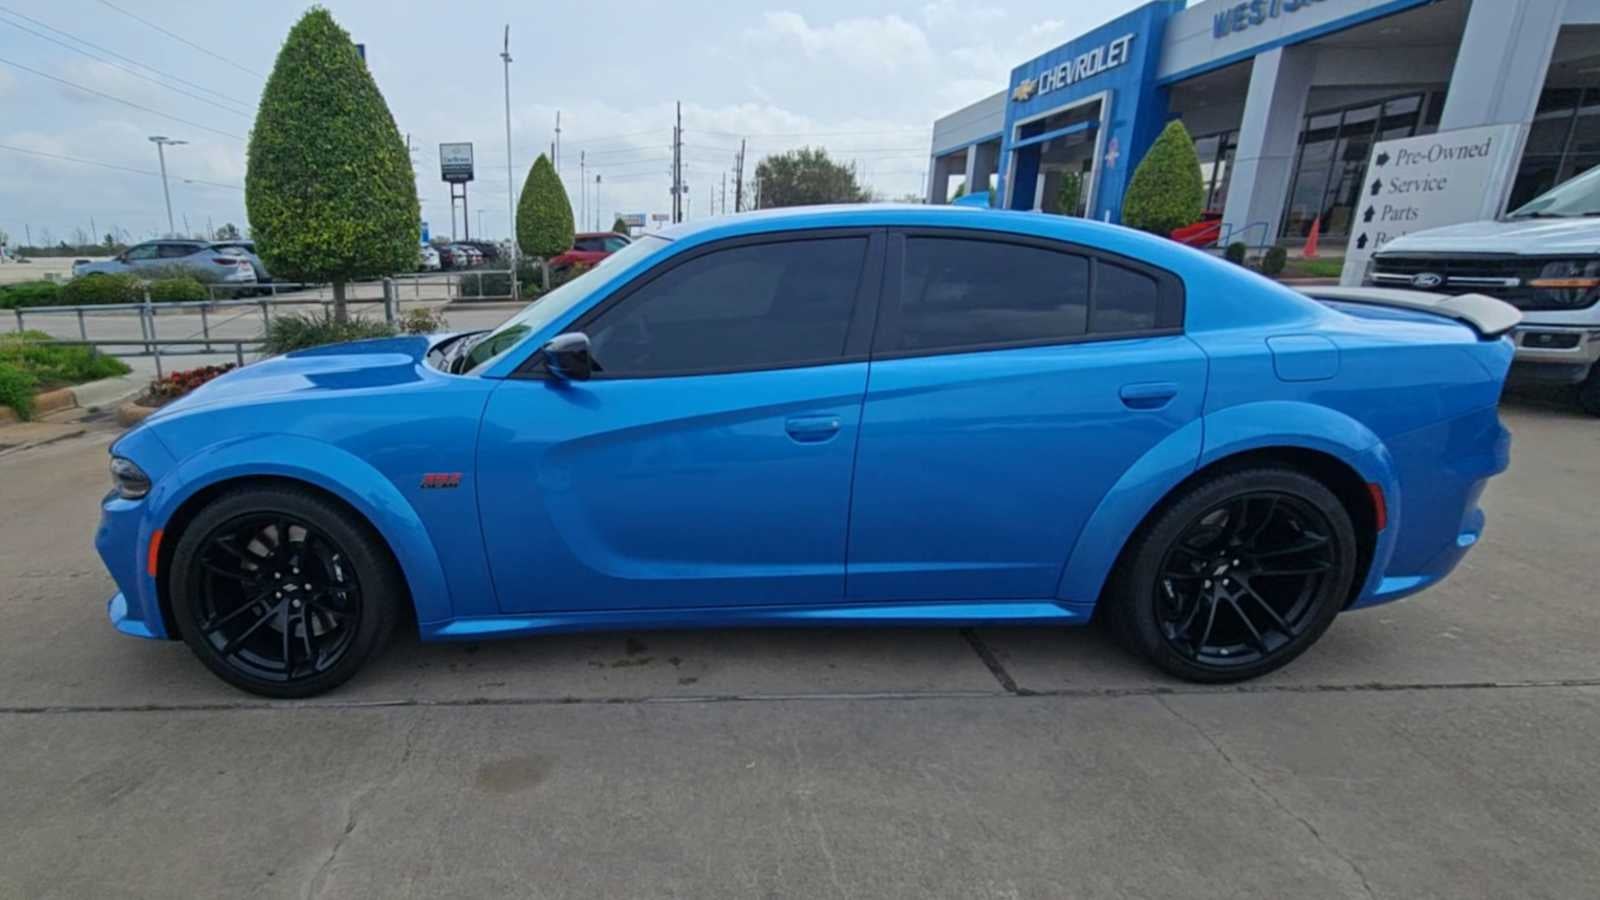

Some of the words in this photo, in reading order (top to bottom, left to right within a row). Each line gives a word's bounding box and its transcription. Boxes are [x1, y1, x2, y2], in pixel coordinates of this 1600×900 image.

[1037, 33, 1134, 95] CHEVROLET
[1395, 137, 1492, 166] Pre-Owned
[1388, 173, 1447, 194] Service
[1380, 204, 1419, 221] Parts
